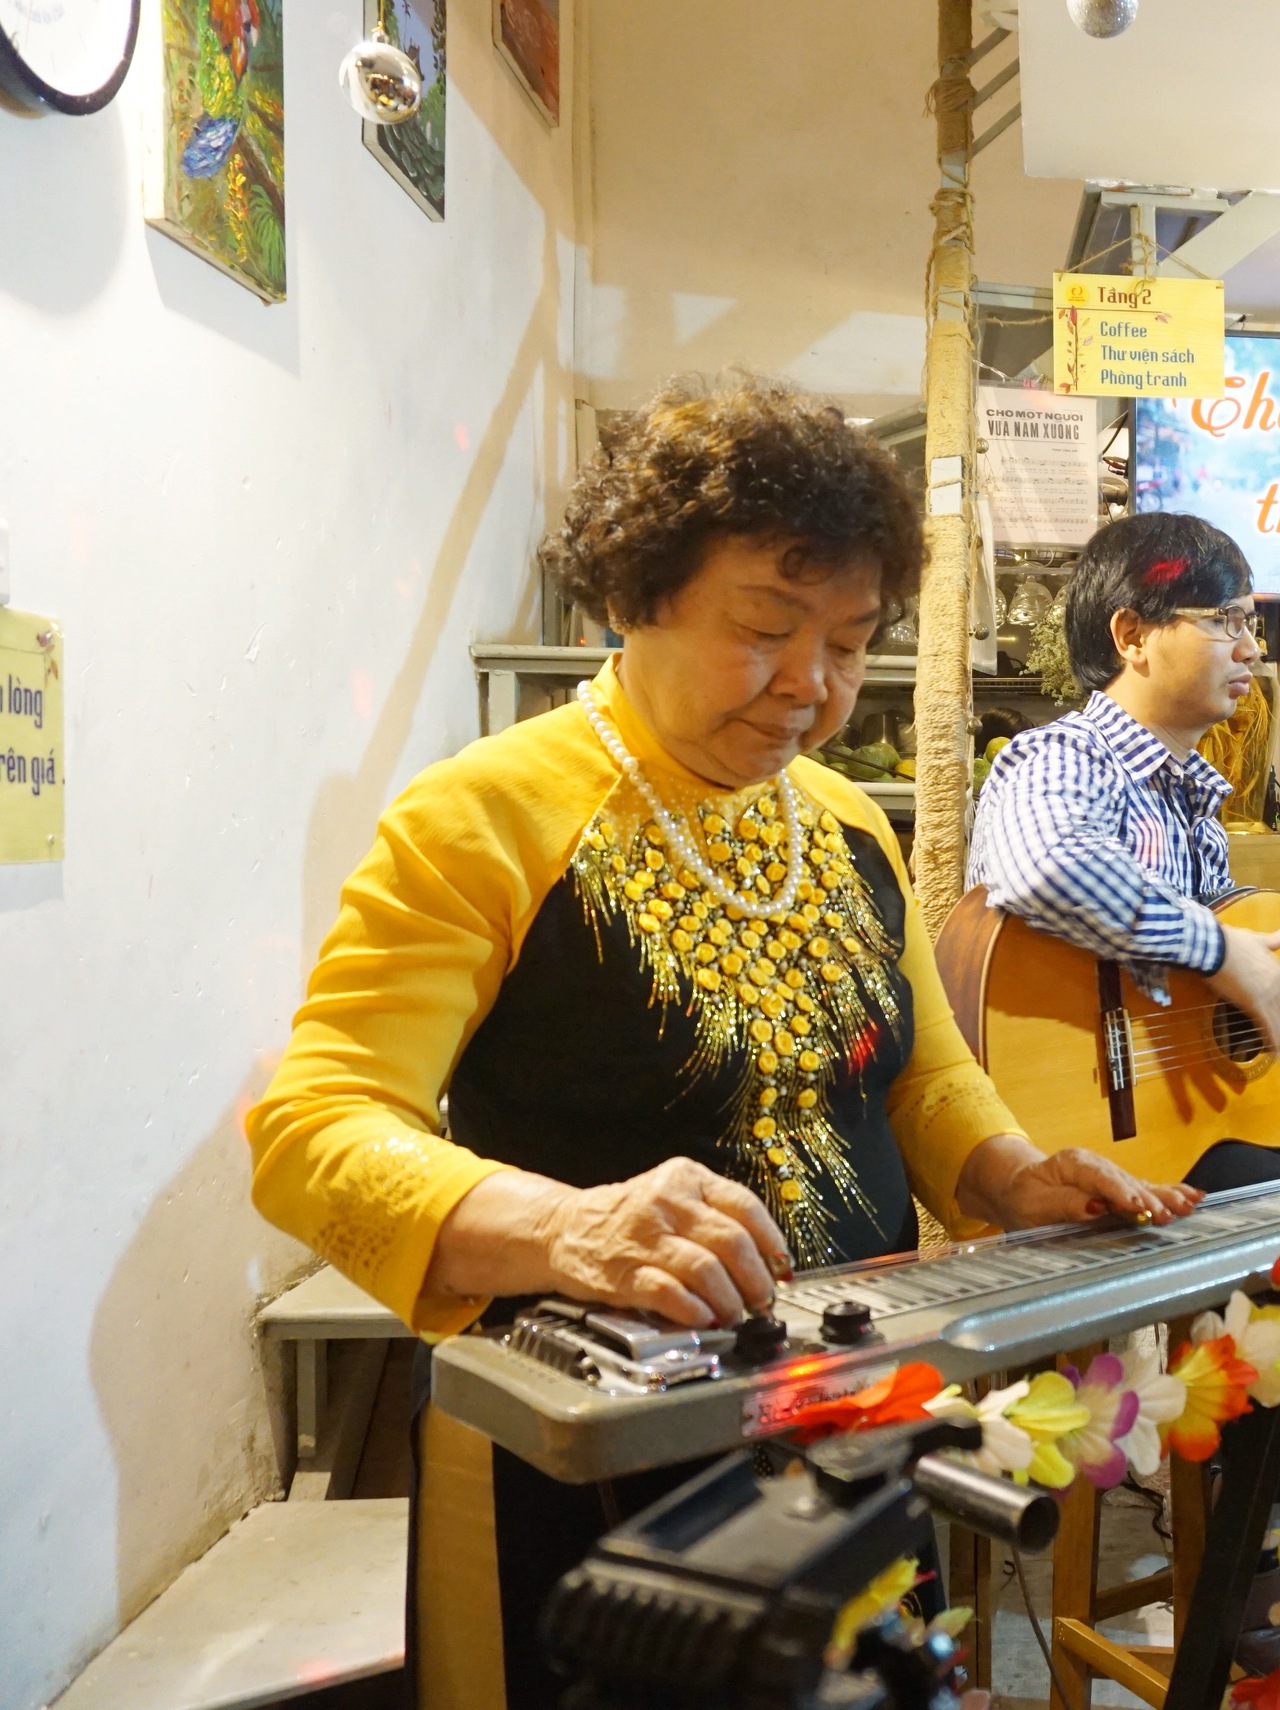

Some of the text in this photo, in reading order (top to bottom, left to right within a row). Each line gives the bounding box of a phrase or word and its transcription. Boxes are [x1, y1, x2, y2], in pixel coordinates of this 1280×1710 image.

[1097, 286, 1152, 309] Tầng 2
[1100, 321, 1147, 338] Coffee
[1101, 345, 1195, 365] Thư viện sách
[1101, 369, 1187, 390] Phòng tranh
[986, 409, 1015, 418] CHO
[8, 673, 43, 729] lòng
[31, 748, 56, 797] giá
